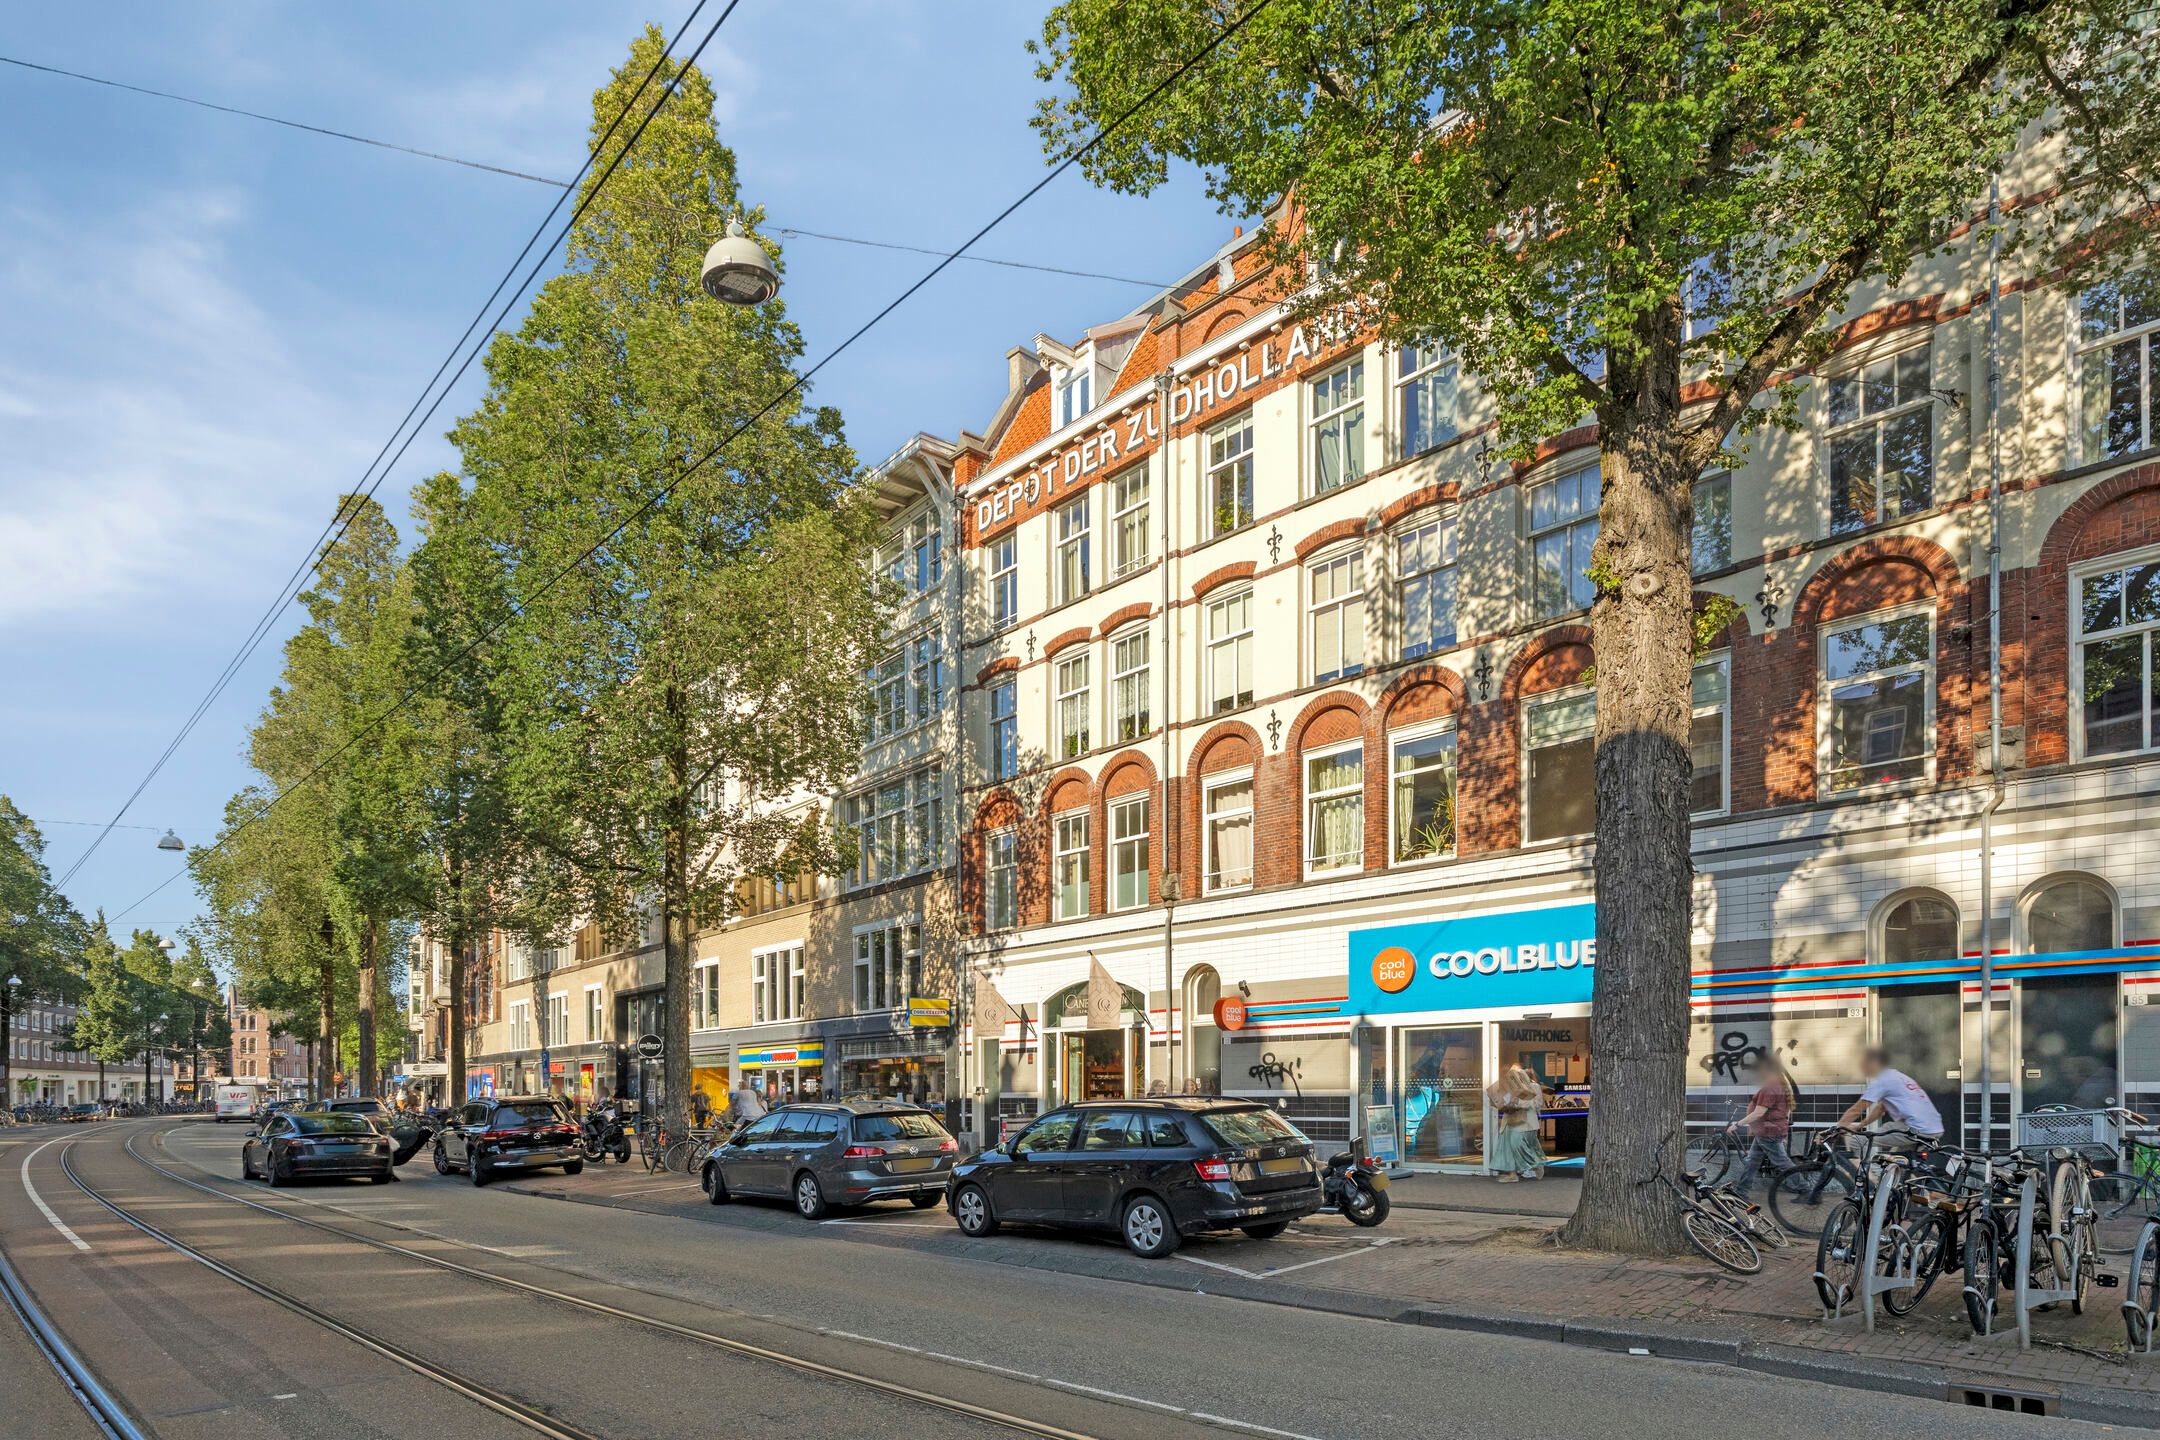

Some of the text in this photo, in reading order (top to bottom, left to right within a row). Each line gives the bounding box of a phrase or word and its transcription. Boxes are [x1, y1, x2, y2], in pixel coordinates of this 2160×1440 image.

[978, 460, 1059, 532] DEPOT
[1064, 430, 1119, 485] DER
[1379, 958, 1405, 970] cool
[1429, 939, 1597, 979] COOLBLUE
[1379, 969, 1406, 981] blue
[2131, 995, 2144, 1005] 95
[1225, 1006, 1242, 1014] cool
[1848, 1008, 1861, 1017] 93
